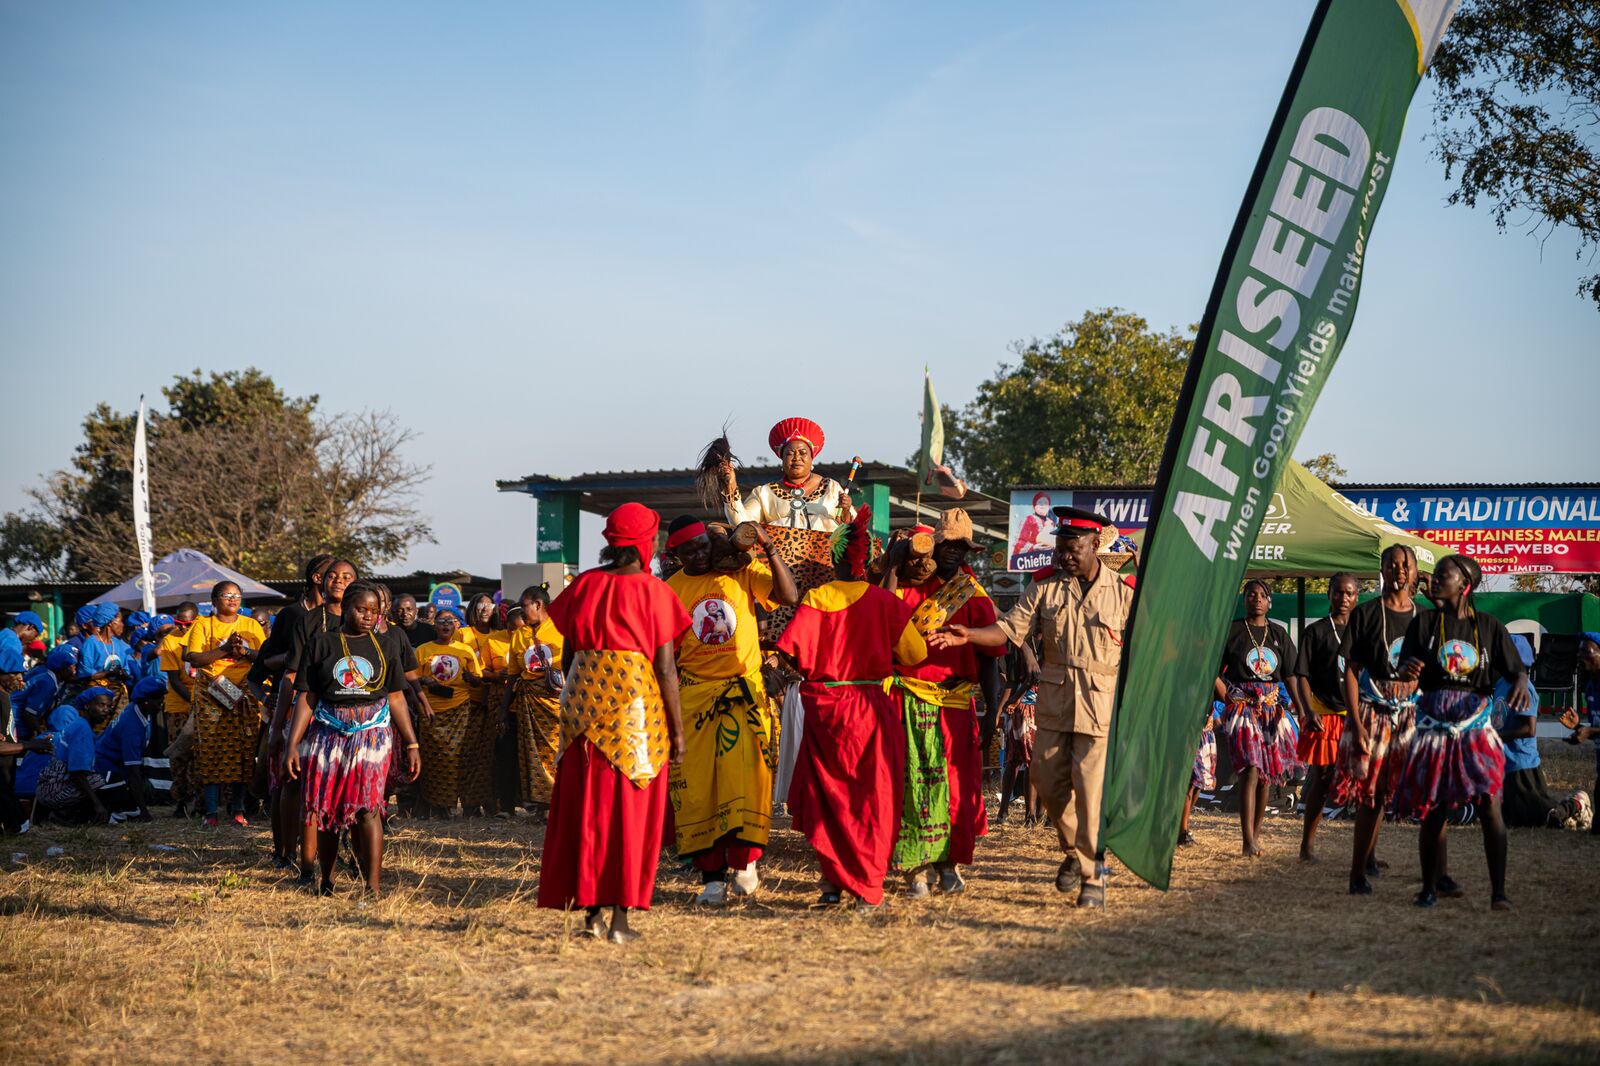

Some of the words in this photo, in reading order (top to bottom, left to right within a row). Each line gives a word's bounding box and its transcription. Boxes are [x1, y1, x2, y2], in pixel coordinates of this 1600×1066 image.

[1173, 107, 1372, 563] AFRISEED
[1222, 485, 1261, 562] When
[1253, 398, 1294, 479] Good
[1279, 318, 1337, 408] Yields
[1327, 230, 1367, 317] matter
[1391, 497, 1410, 522] &
[1420, 496, 1600, 522] TRADITIONAL
[1423, 529, 1544, 542] CHIEFTAINESS
[1466, 543, 1570, 555] SHAFWEBO
